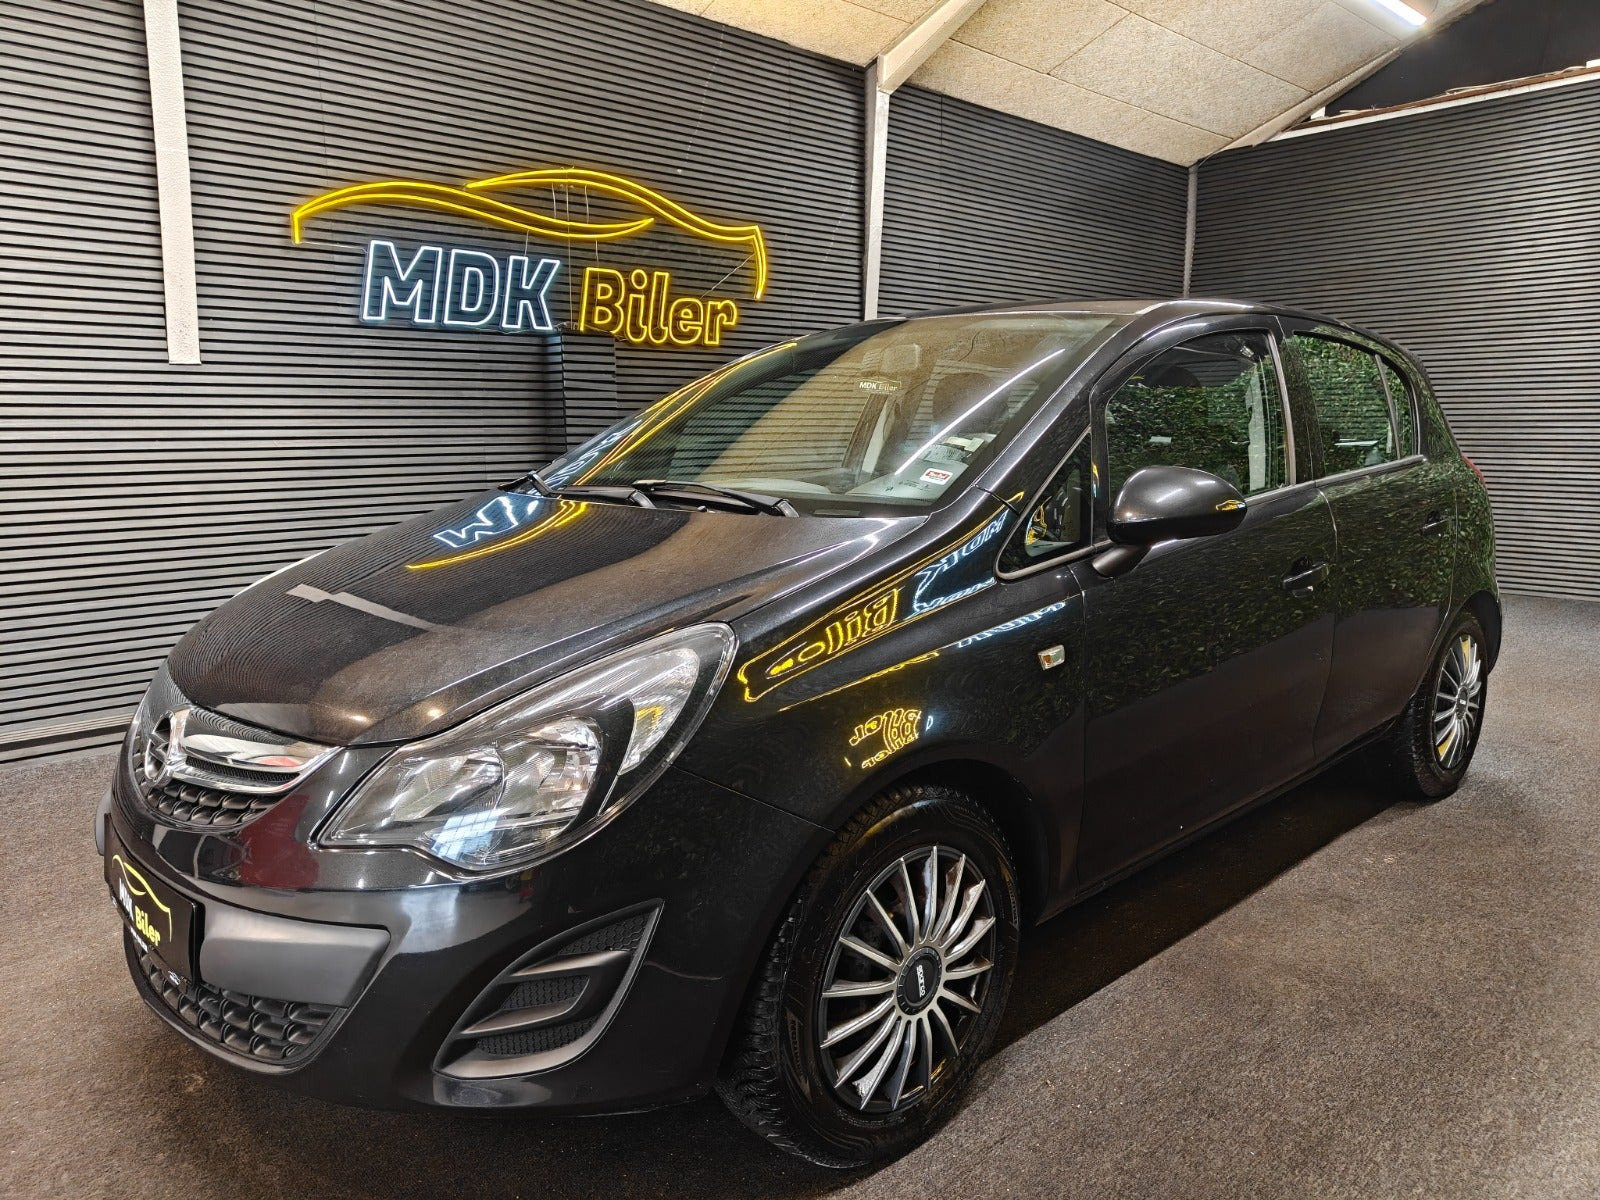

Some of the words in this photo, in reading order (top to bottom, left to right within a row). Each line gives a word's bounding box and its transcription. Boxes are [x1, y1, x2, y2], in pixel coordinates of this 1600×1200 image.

[361, 240, 561, 332] MDK
[579, 267, 737, 346] Biler
[859, 381, 878, 390] MDK
[135, 905, 160, 947] Biler
